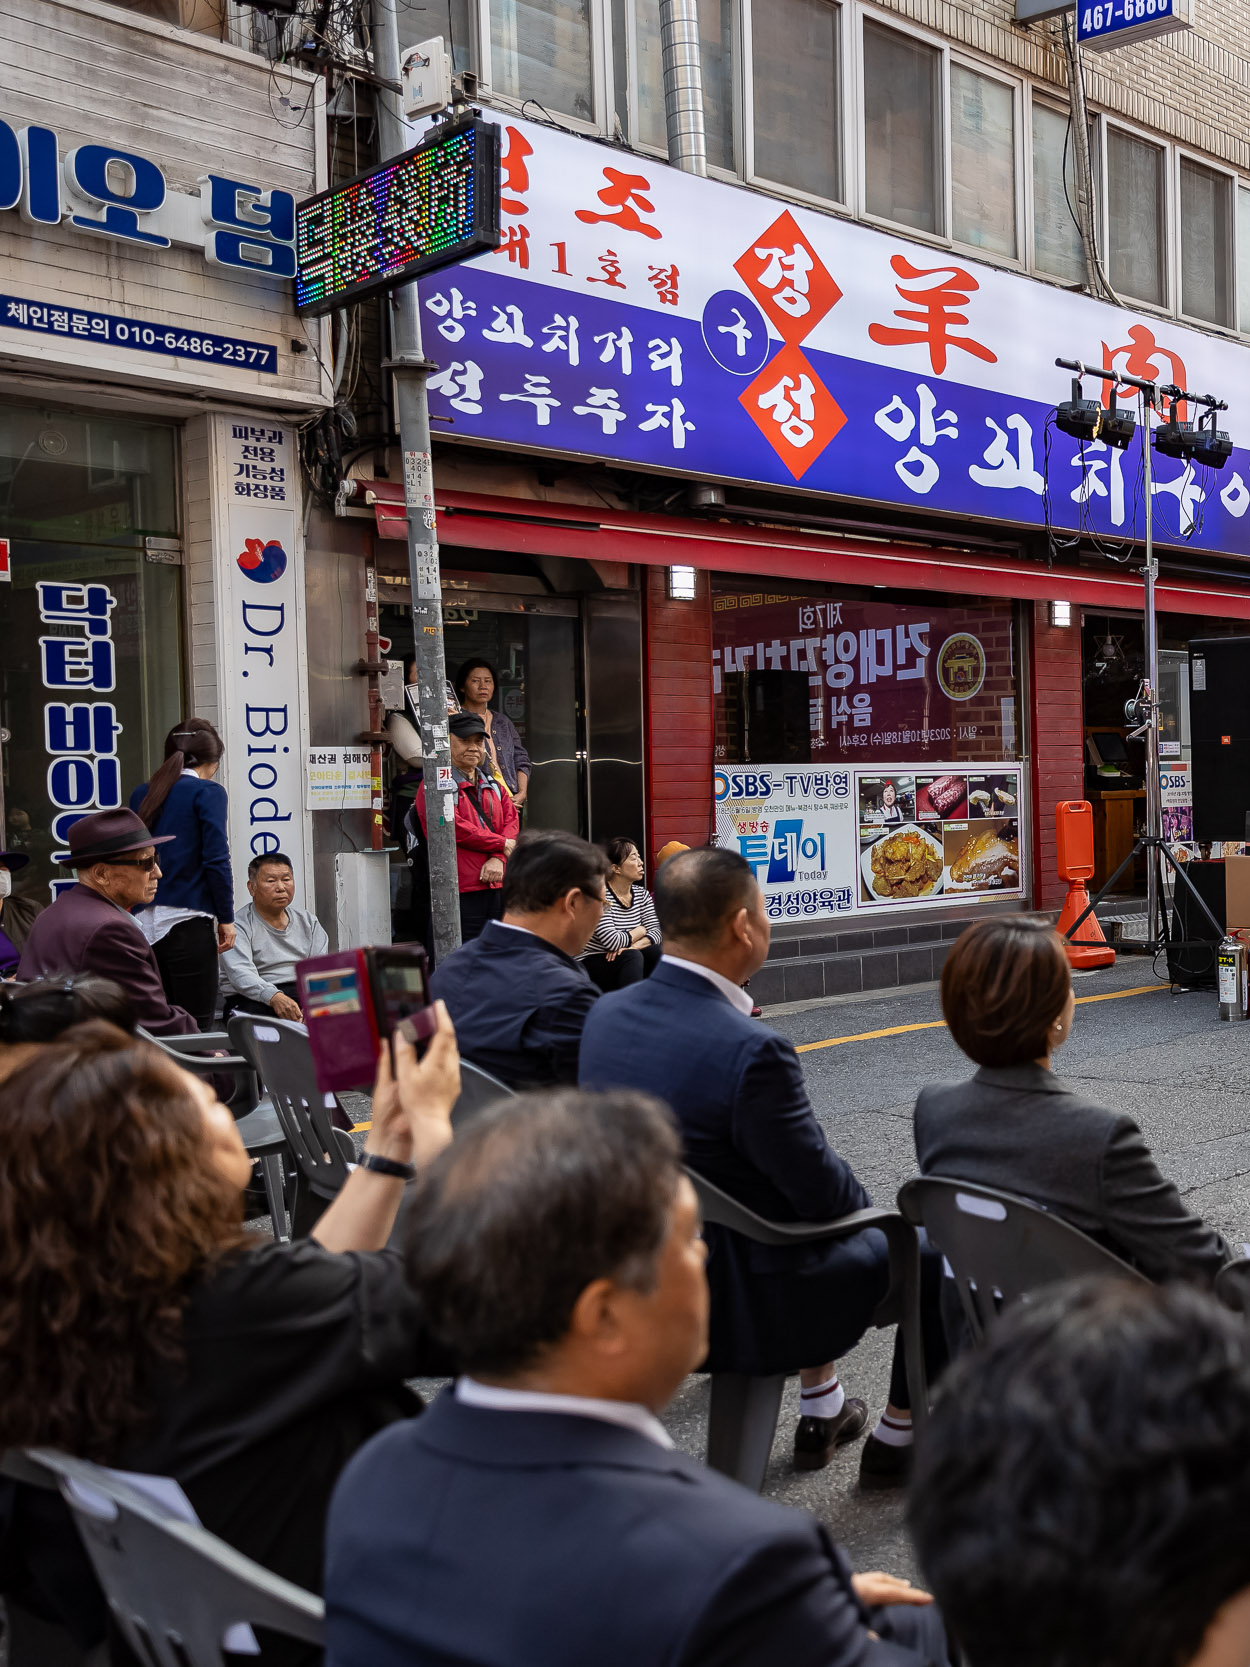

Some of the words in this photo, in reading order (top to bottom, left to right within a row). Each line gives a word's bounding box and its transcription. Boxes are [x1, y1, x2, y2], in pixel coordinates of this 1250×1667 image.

[7, 302, 110, 340] 체인점문의
[116, 323, 270, 366] 010-6486-2377
[425, 287, 683, 387] 양꼬치거리
[426, 360, 696, 449] 선두주자
[232, 425, 285, 445] 피부과
[240, 445, 276, 463] 전용
[233, 463, 286, 482] 기능성
[234, 480, 287, 501] 화장품
[35, 581, 117, 692] 닥터
[240, 600, 285, 678] Dr.
[342, 753, 371, 764] 침해하
[244, 702, 293, 857] Biode
[347, 770, 371, 780] 결사반
[731, 771, 850, 799] SBS-TV방영
[737, 821, 769, 834] 생방송
[736, 832, 825, 882] 투데이
[798, 870, 829, 881] Today
[765, 886, 853, 918] 경성양육관
